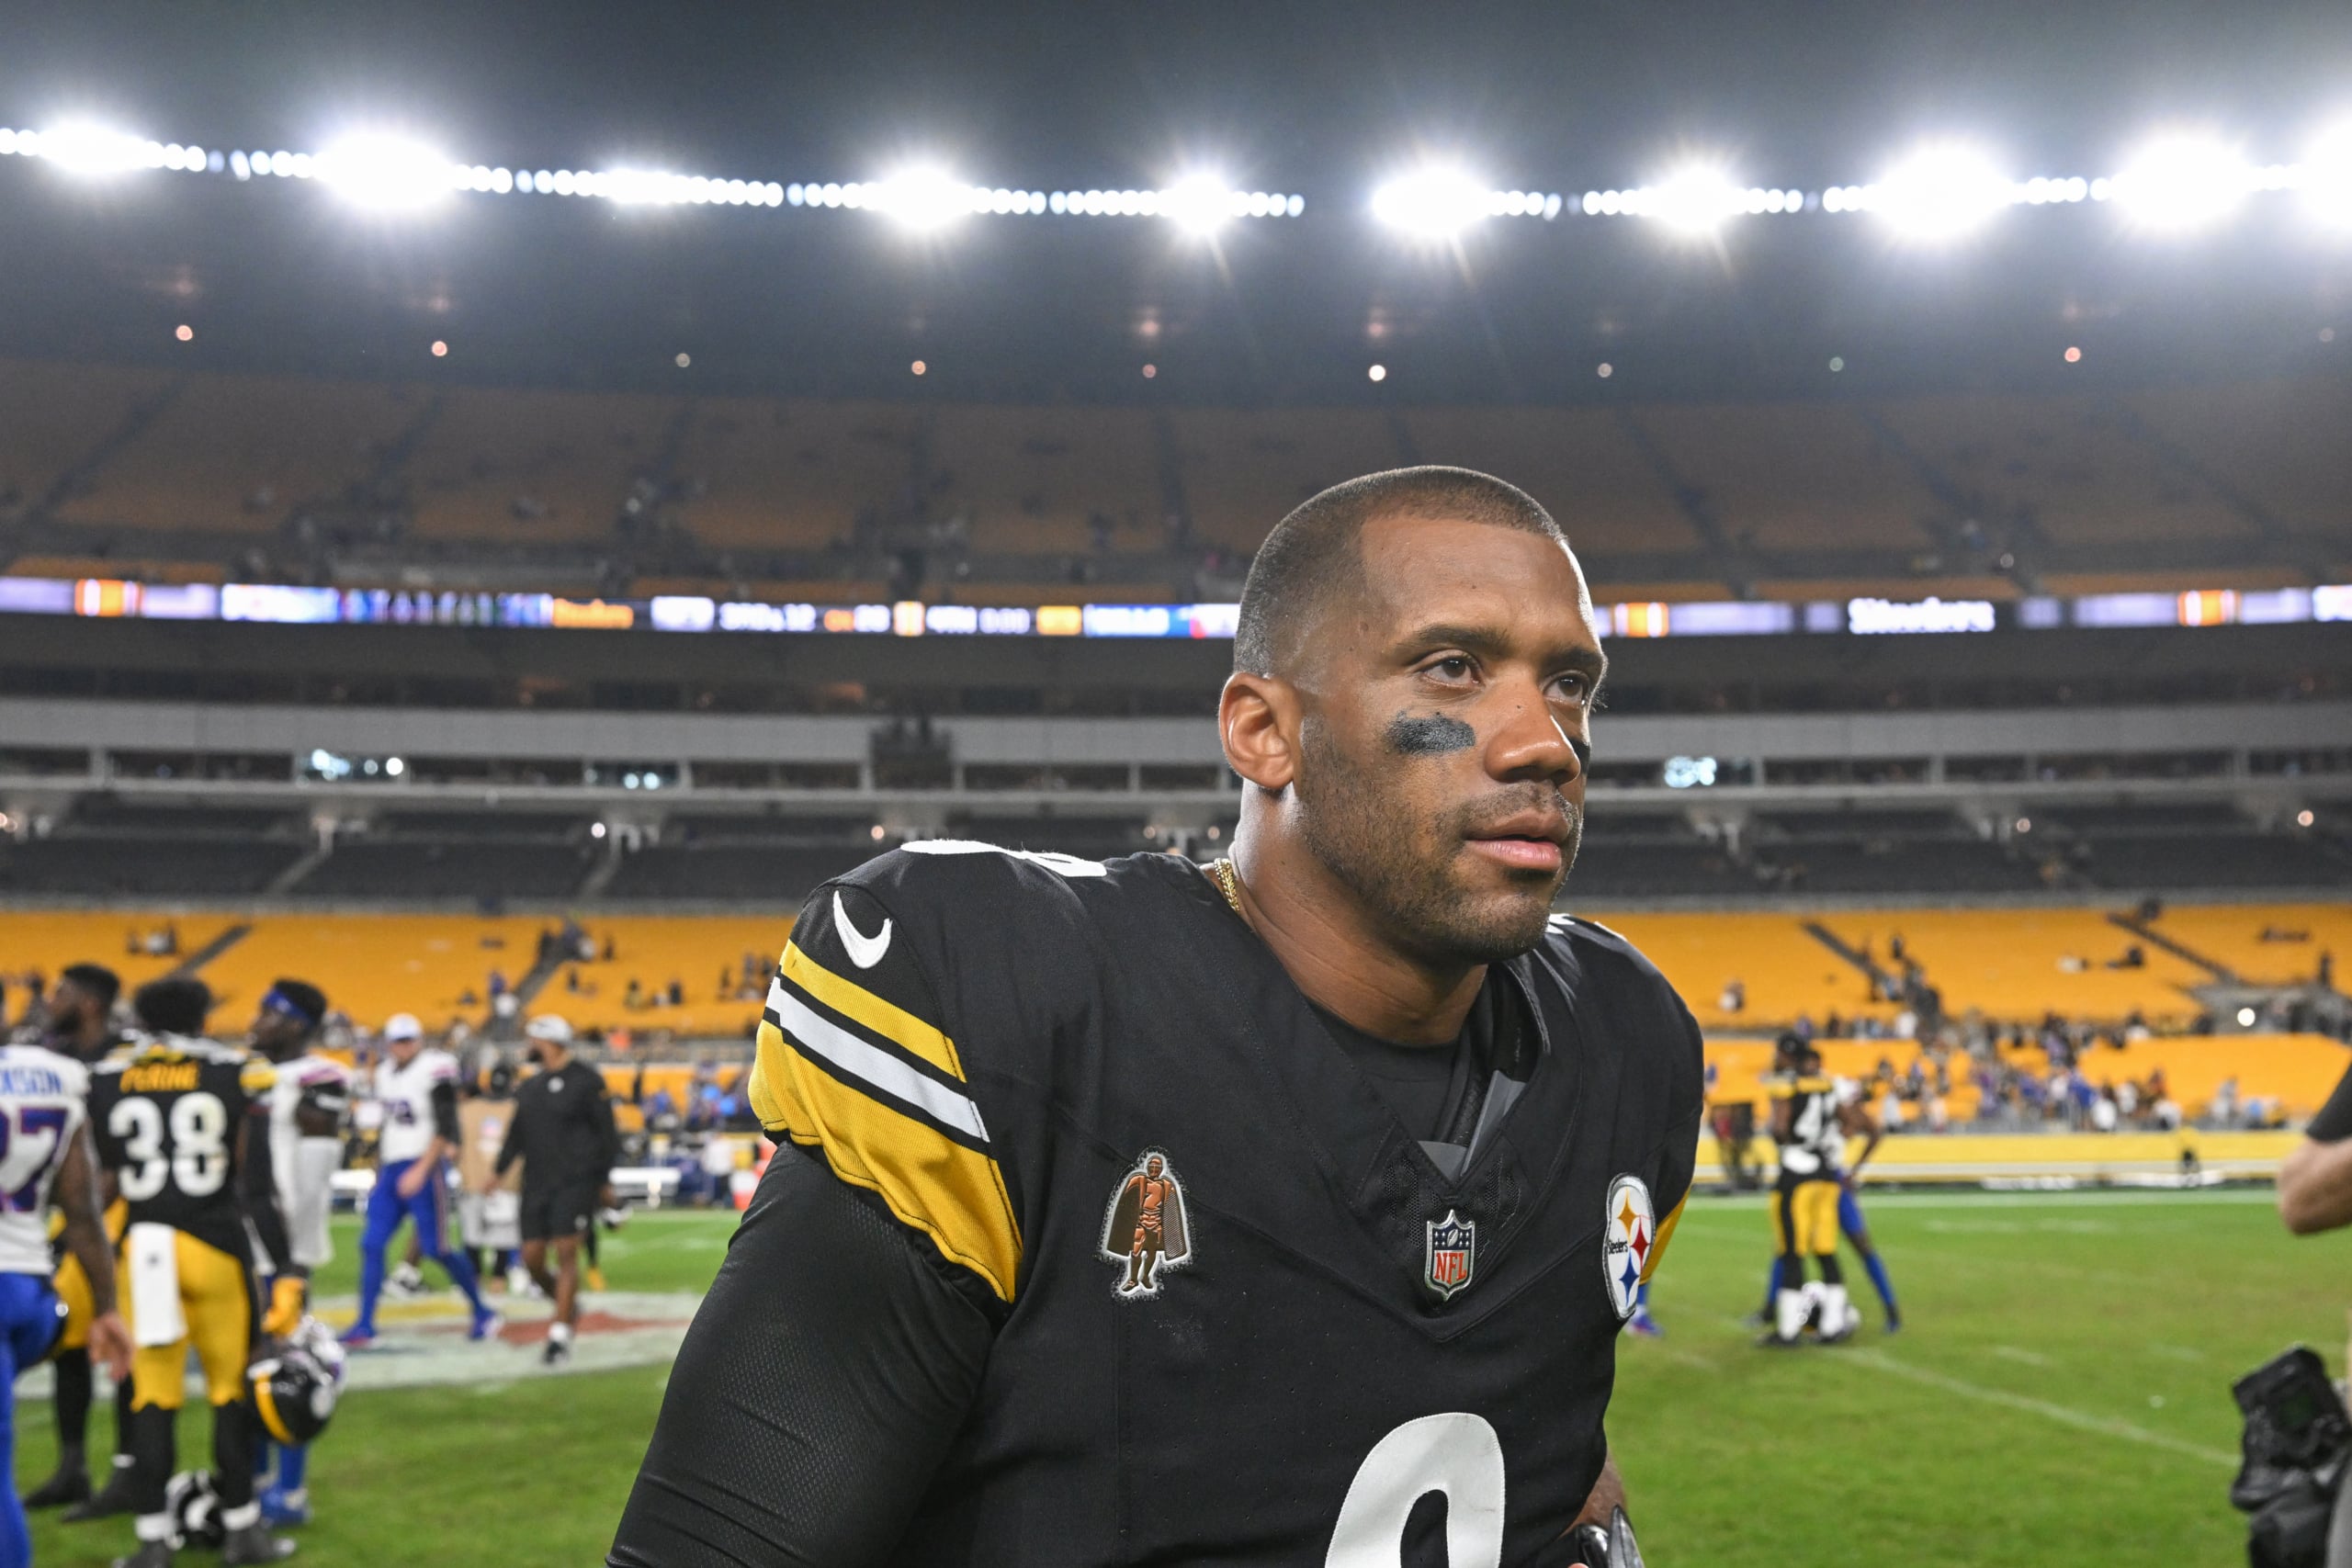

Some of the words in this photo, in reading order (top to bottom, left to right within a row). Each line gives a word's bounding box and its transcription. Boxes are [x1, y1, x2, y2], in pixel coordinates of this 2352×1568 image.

[0, 1107, 69, 1212] 7
[108, 1092, 228, 1201] 38
[1434, 1252, 1467, 1285] NFL
